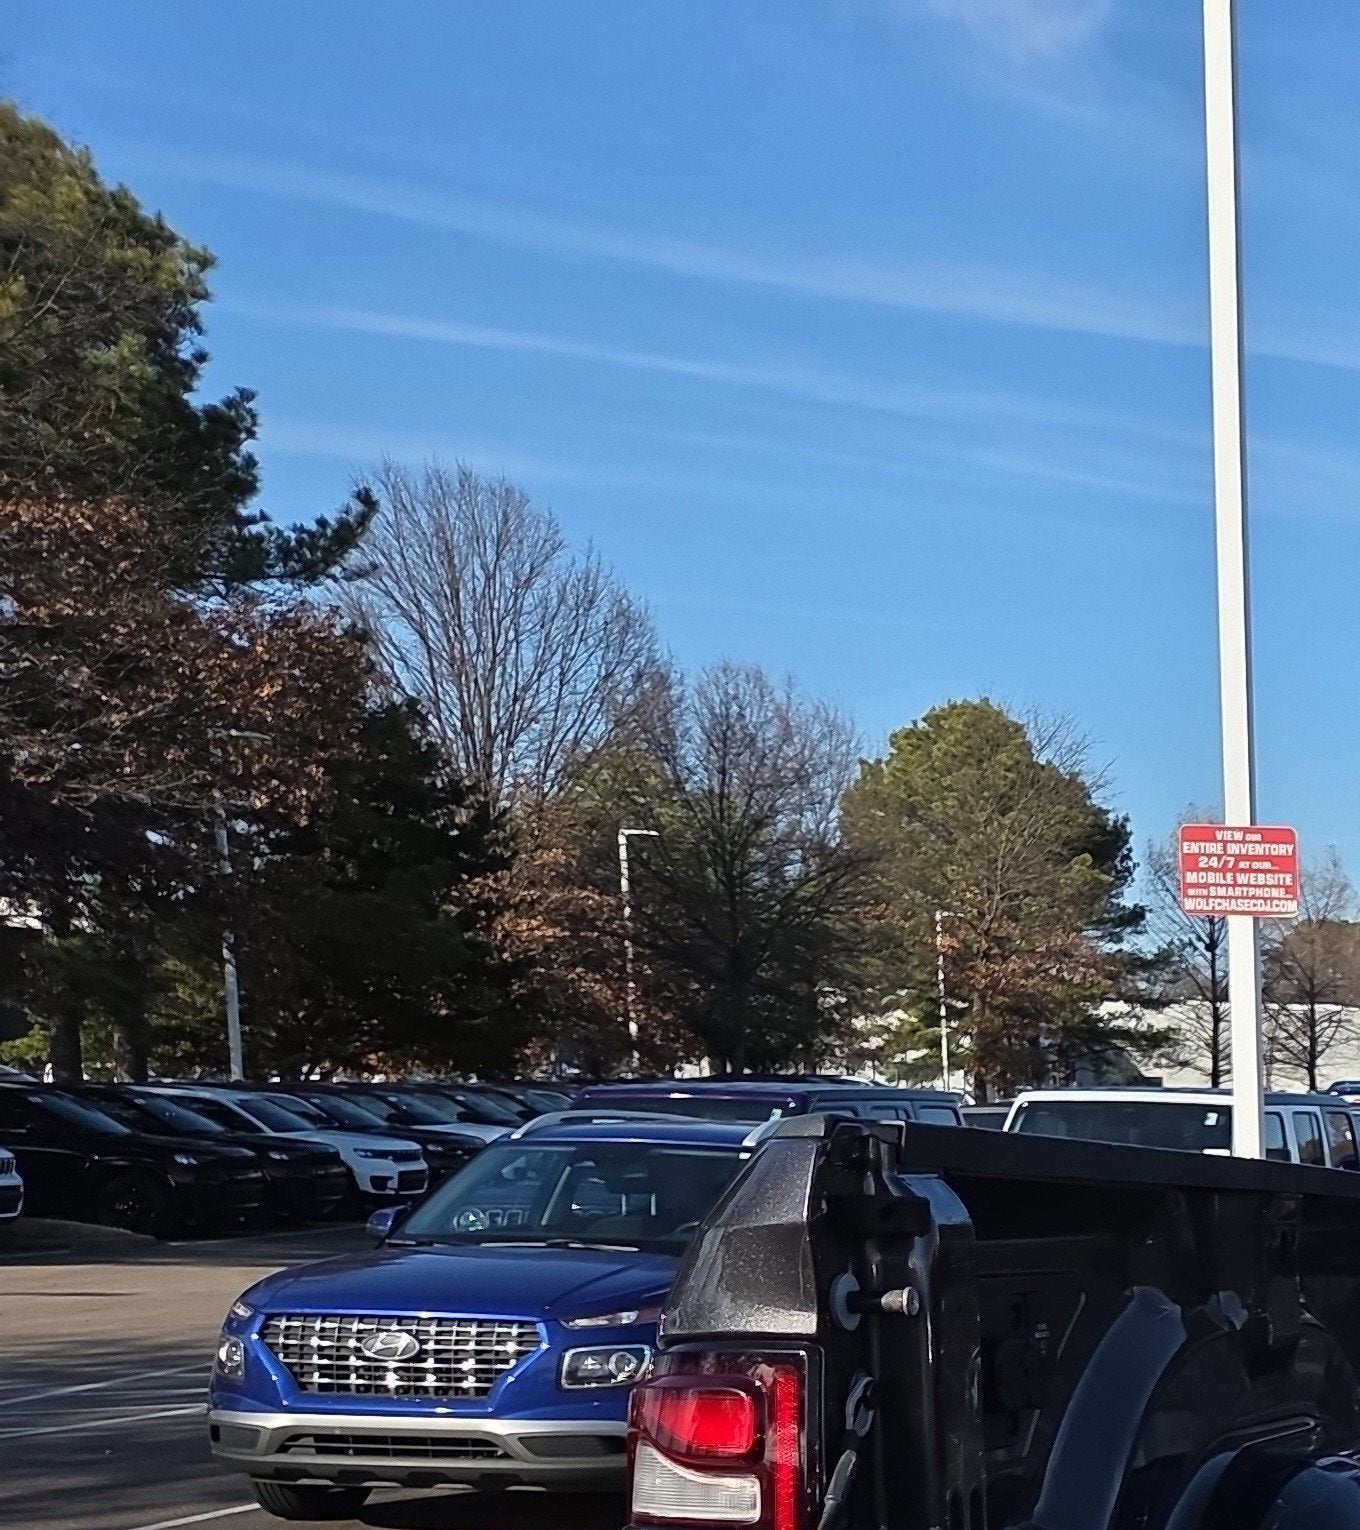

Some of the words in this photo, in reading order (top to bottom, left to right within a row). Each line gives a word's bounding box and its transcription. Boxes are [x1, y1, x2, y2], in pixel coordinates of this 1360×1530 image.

[1215, 830, 1244, 841] VIEW
[1183, 842, 1224, 854] ENTIRE
[1226, 843, 1294, 856] INVENTORY
[1198, 855, 1235, 869] 24/7
[1239, 861, 1250, 869] AT
[1185, 871, 1234, 884] MOBILE
[1235, 872, 1293, 886] WEBSITE
[1184, 897, 1298, 912] WOLFCHASECDJ.COM
